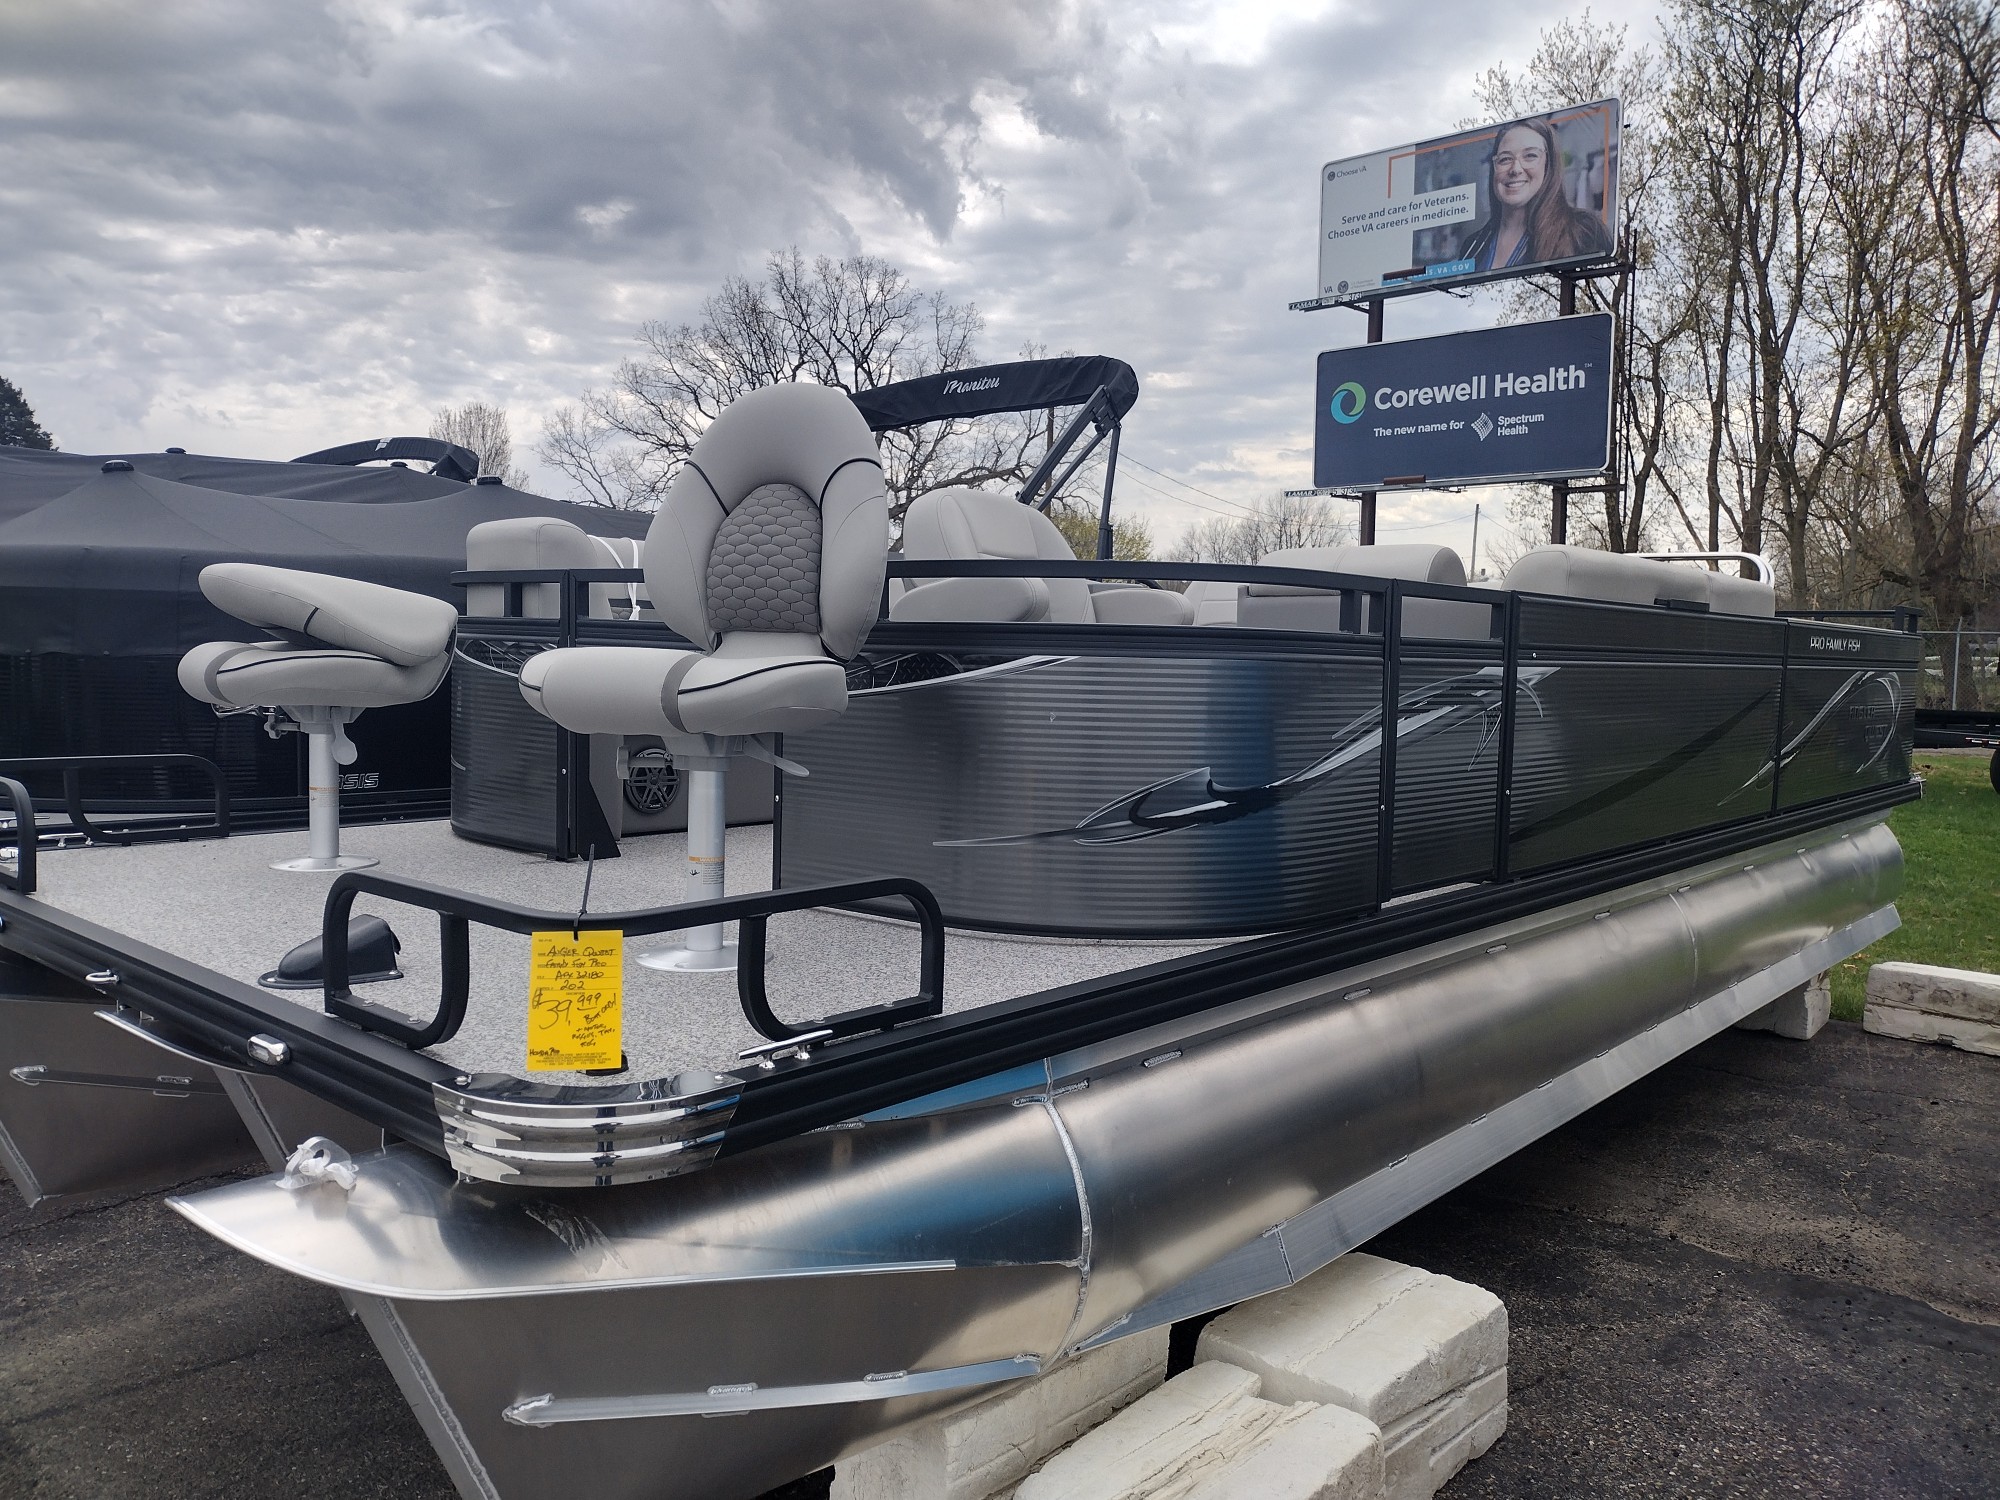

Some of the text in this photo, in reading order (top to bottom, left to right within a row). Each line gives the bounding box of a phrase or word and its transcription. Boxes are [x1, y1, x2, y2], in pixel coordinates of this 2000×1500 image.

[1337, 169, 1358, 178] Choose
[1341, 192, 1470, 225] Serve and care for Veterans.
[1327, 205, 1469, 240] Choose VA careers in medicine.
[1324, 286, 1333, 294] VA
[943, 376, 1000, 395] Manitou
[1374, 374, 1487, 410] Corewell
[1494, 364, 1586, 397] Health
[1497, 413, 1545, 426] Spectrum
[1374, 419, 1465, 437] The new name for
[1497, 425, 1529, 437] Health
[1810, 636, 1825, 650] PRO
[1826, 637, 1847, 650] FAMILY
